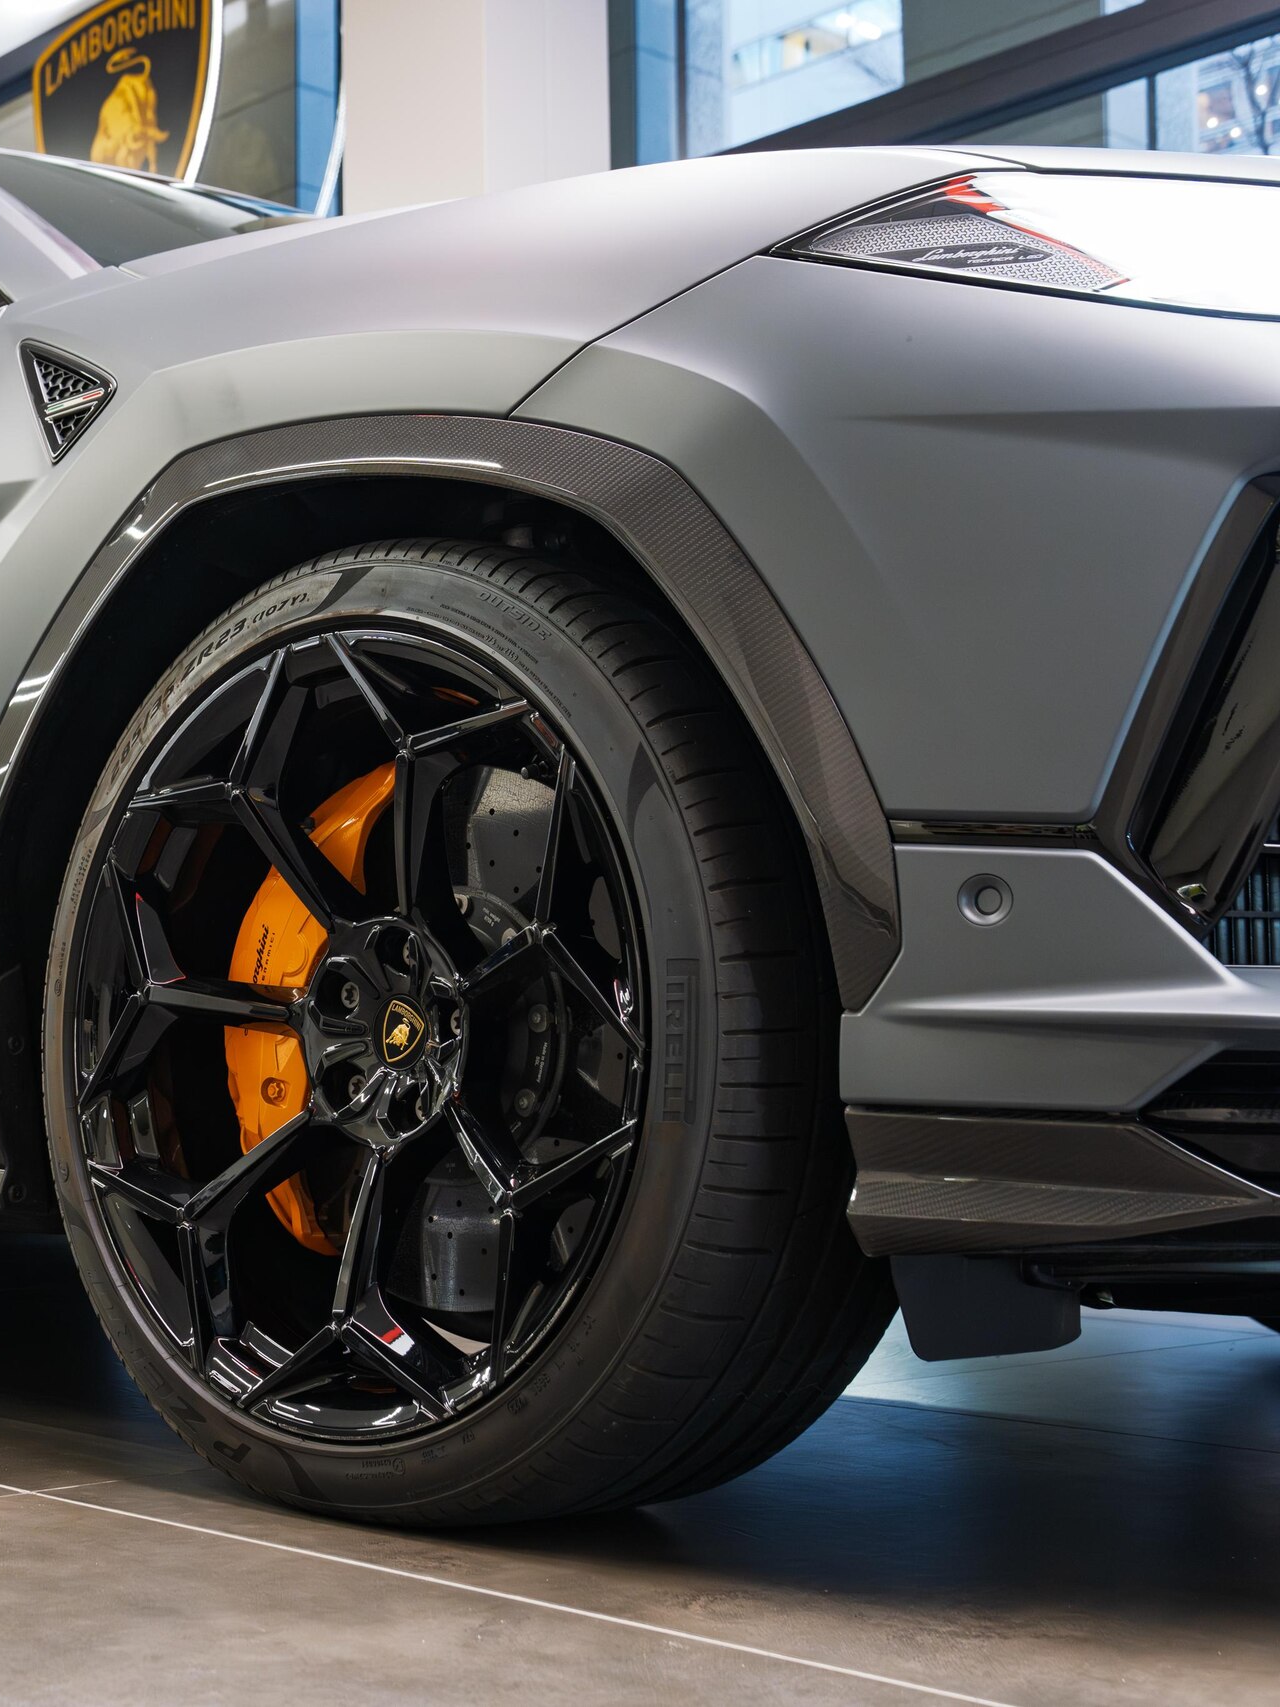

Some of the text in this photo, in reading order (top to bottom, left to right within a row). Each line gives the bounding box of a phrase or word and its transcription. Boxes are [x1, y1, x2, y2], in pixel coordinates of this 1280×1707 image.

[45, 0, 196, 97] LAMBORGHINI
[912, 245, 1023, 262] Lamborghini
[180, 617, 247, 682] ZR23
[252, 592, 308, 624] (107Y)
[479, 591, 552, 641] OUTSIDE
[252, 923, 269, 984] orghini
[391, 1002, 423, 1032] LAMBORGHINI
[663, 957, 701, 1124] PIRELLI
[536, 1061, 545, 1084] Germany
